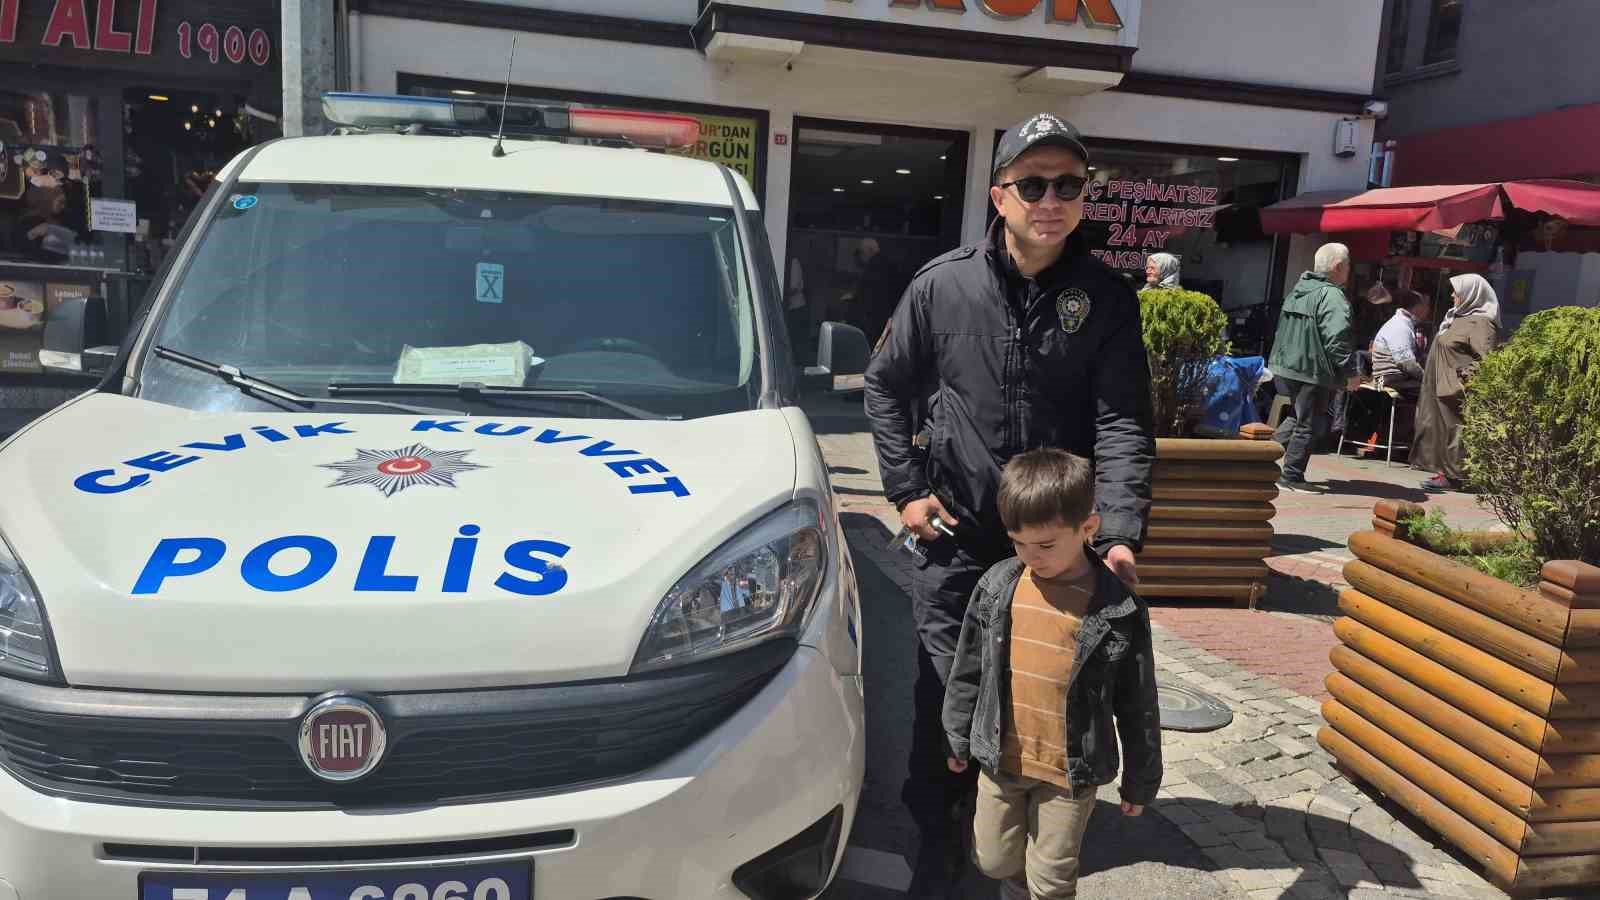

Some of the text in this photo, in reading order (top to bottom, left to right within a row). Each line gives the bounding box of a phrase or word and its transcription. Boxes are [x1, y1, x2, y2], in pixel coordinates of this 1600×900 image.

[177, 21, 270, 65] 1900
[699, 124, 750, 139] UR'DAN
[1107, 178, 1217, 205] PEŞİNATSIZ
[1081, 200, 1128, 222] REDİ
[1106, 223, 1170, 249] 24 AY
[73, 420, 691, 498] ÇEVİK KUVVET
[130, 523, 572, 596] POLİS
[319, 724, 367, 759] FIAT
